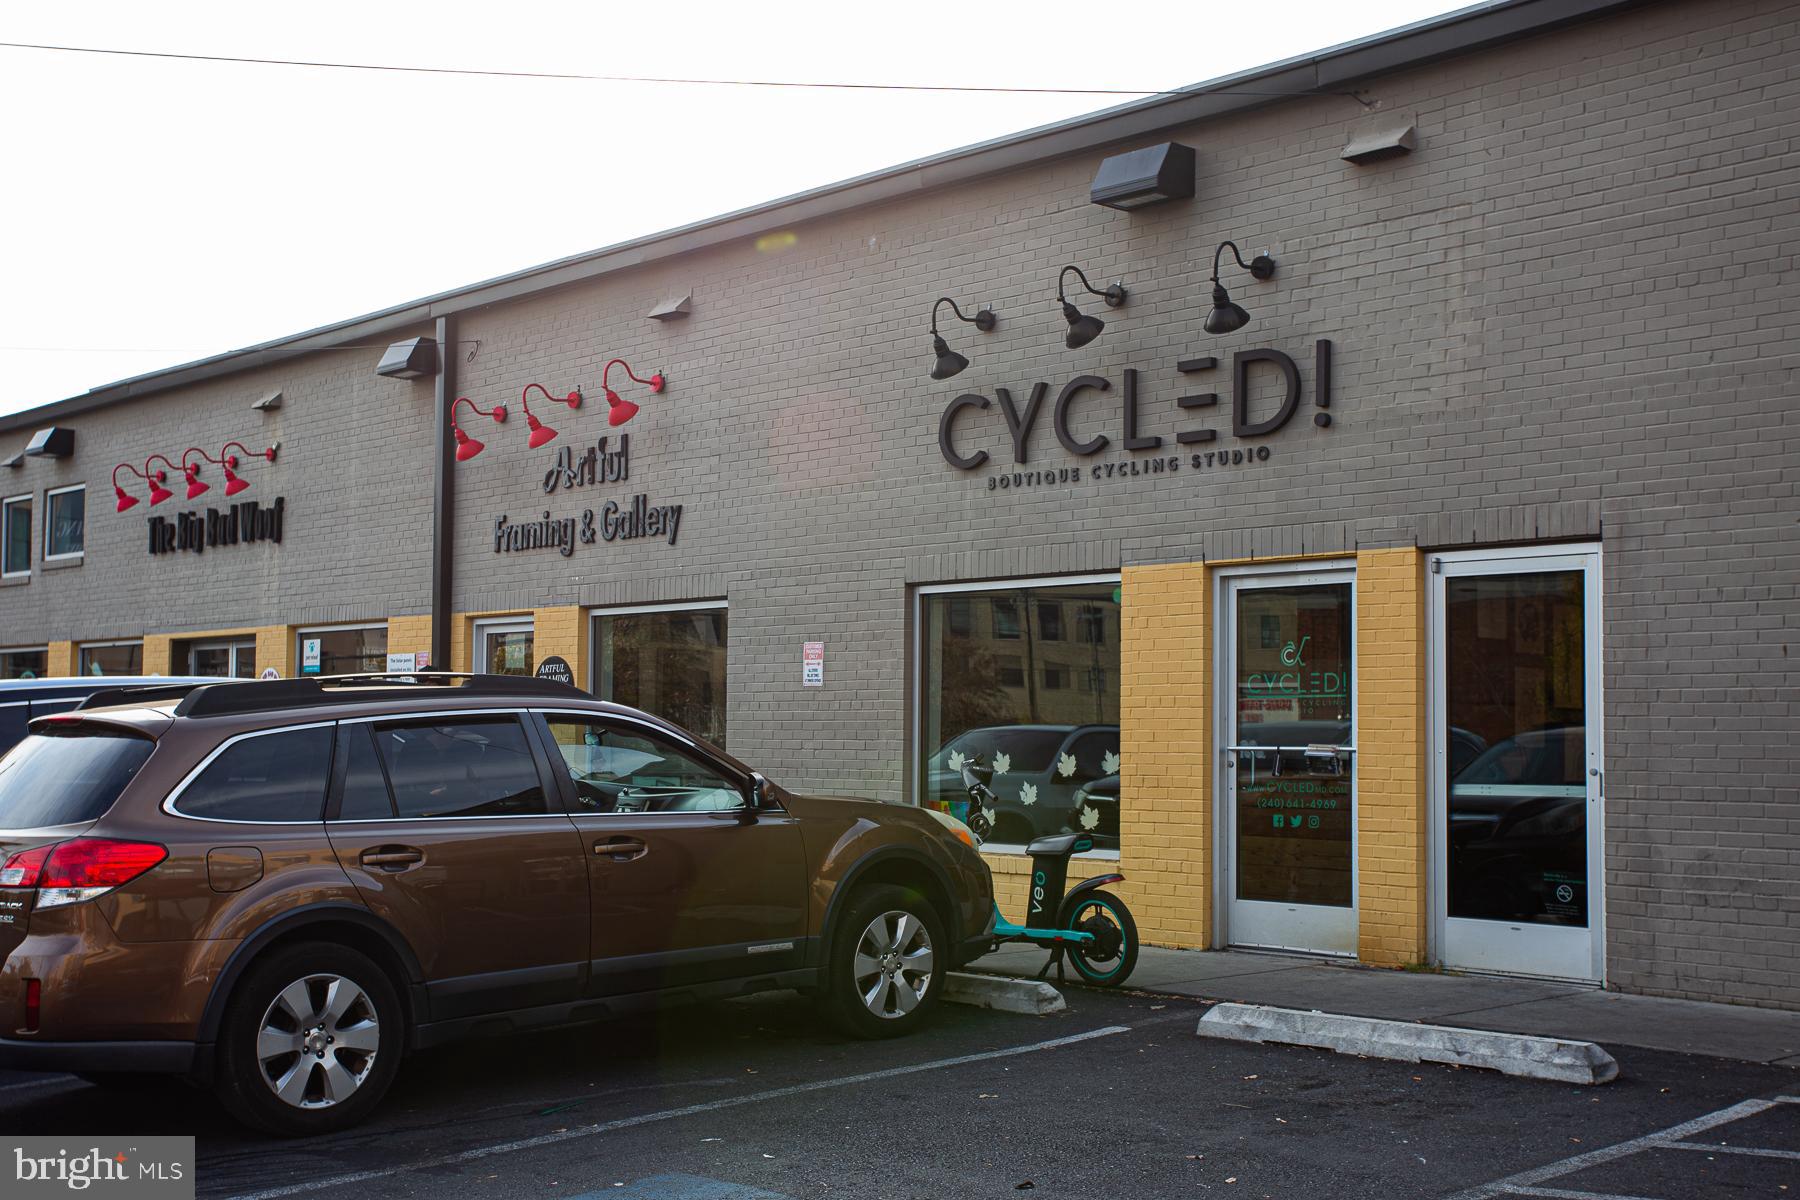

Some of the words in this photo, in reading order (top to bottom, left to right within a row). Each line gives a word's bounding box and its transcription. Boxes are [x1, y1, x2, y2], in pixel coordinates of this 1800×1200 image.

[938, 339, 1332, 470] CYCLED!
[543, 433, 628, 493] Artful
[988, 467, 1081, 490] BOUTIQUE
[1091, 456, 1178, 481] CYCLING
[1191, 445, 1271, 469] STUDIO
[148, 516, 176, 555] The
[177, 511, 205, 553] Big
[206, 504, 239, 547] Bad
[240, 496, 285, 544] Woof
[494, 510, 575, 557] Framing
[580, 509, 596, 544] &
[601, 494, 683, 545] Gallery
[539, 664, 564, 674] ARTFUL
[1247, 671, 1347, 694] CYCLED!
[1032, 871, 1047, 914] veo
